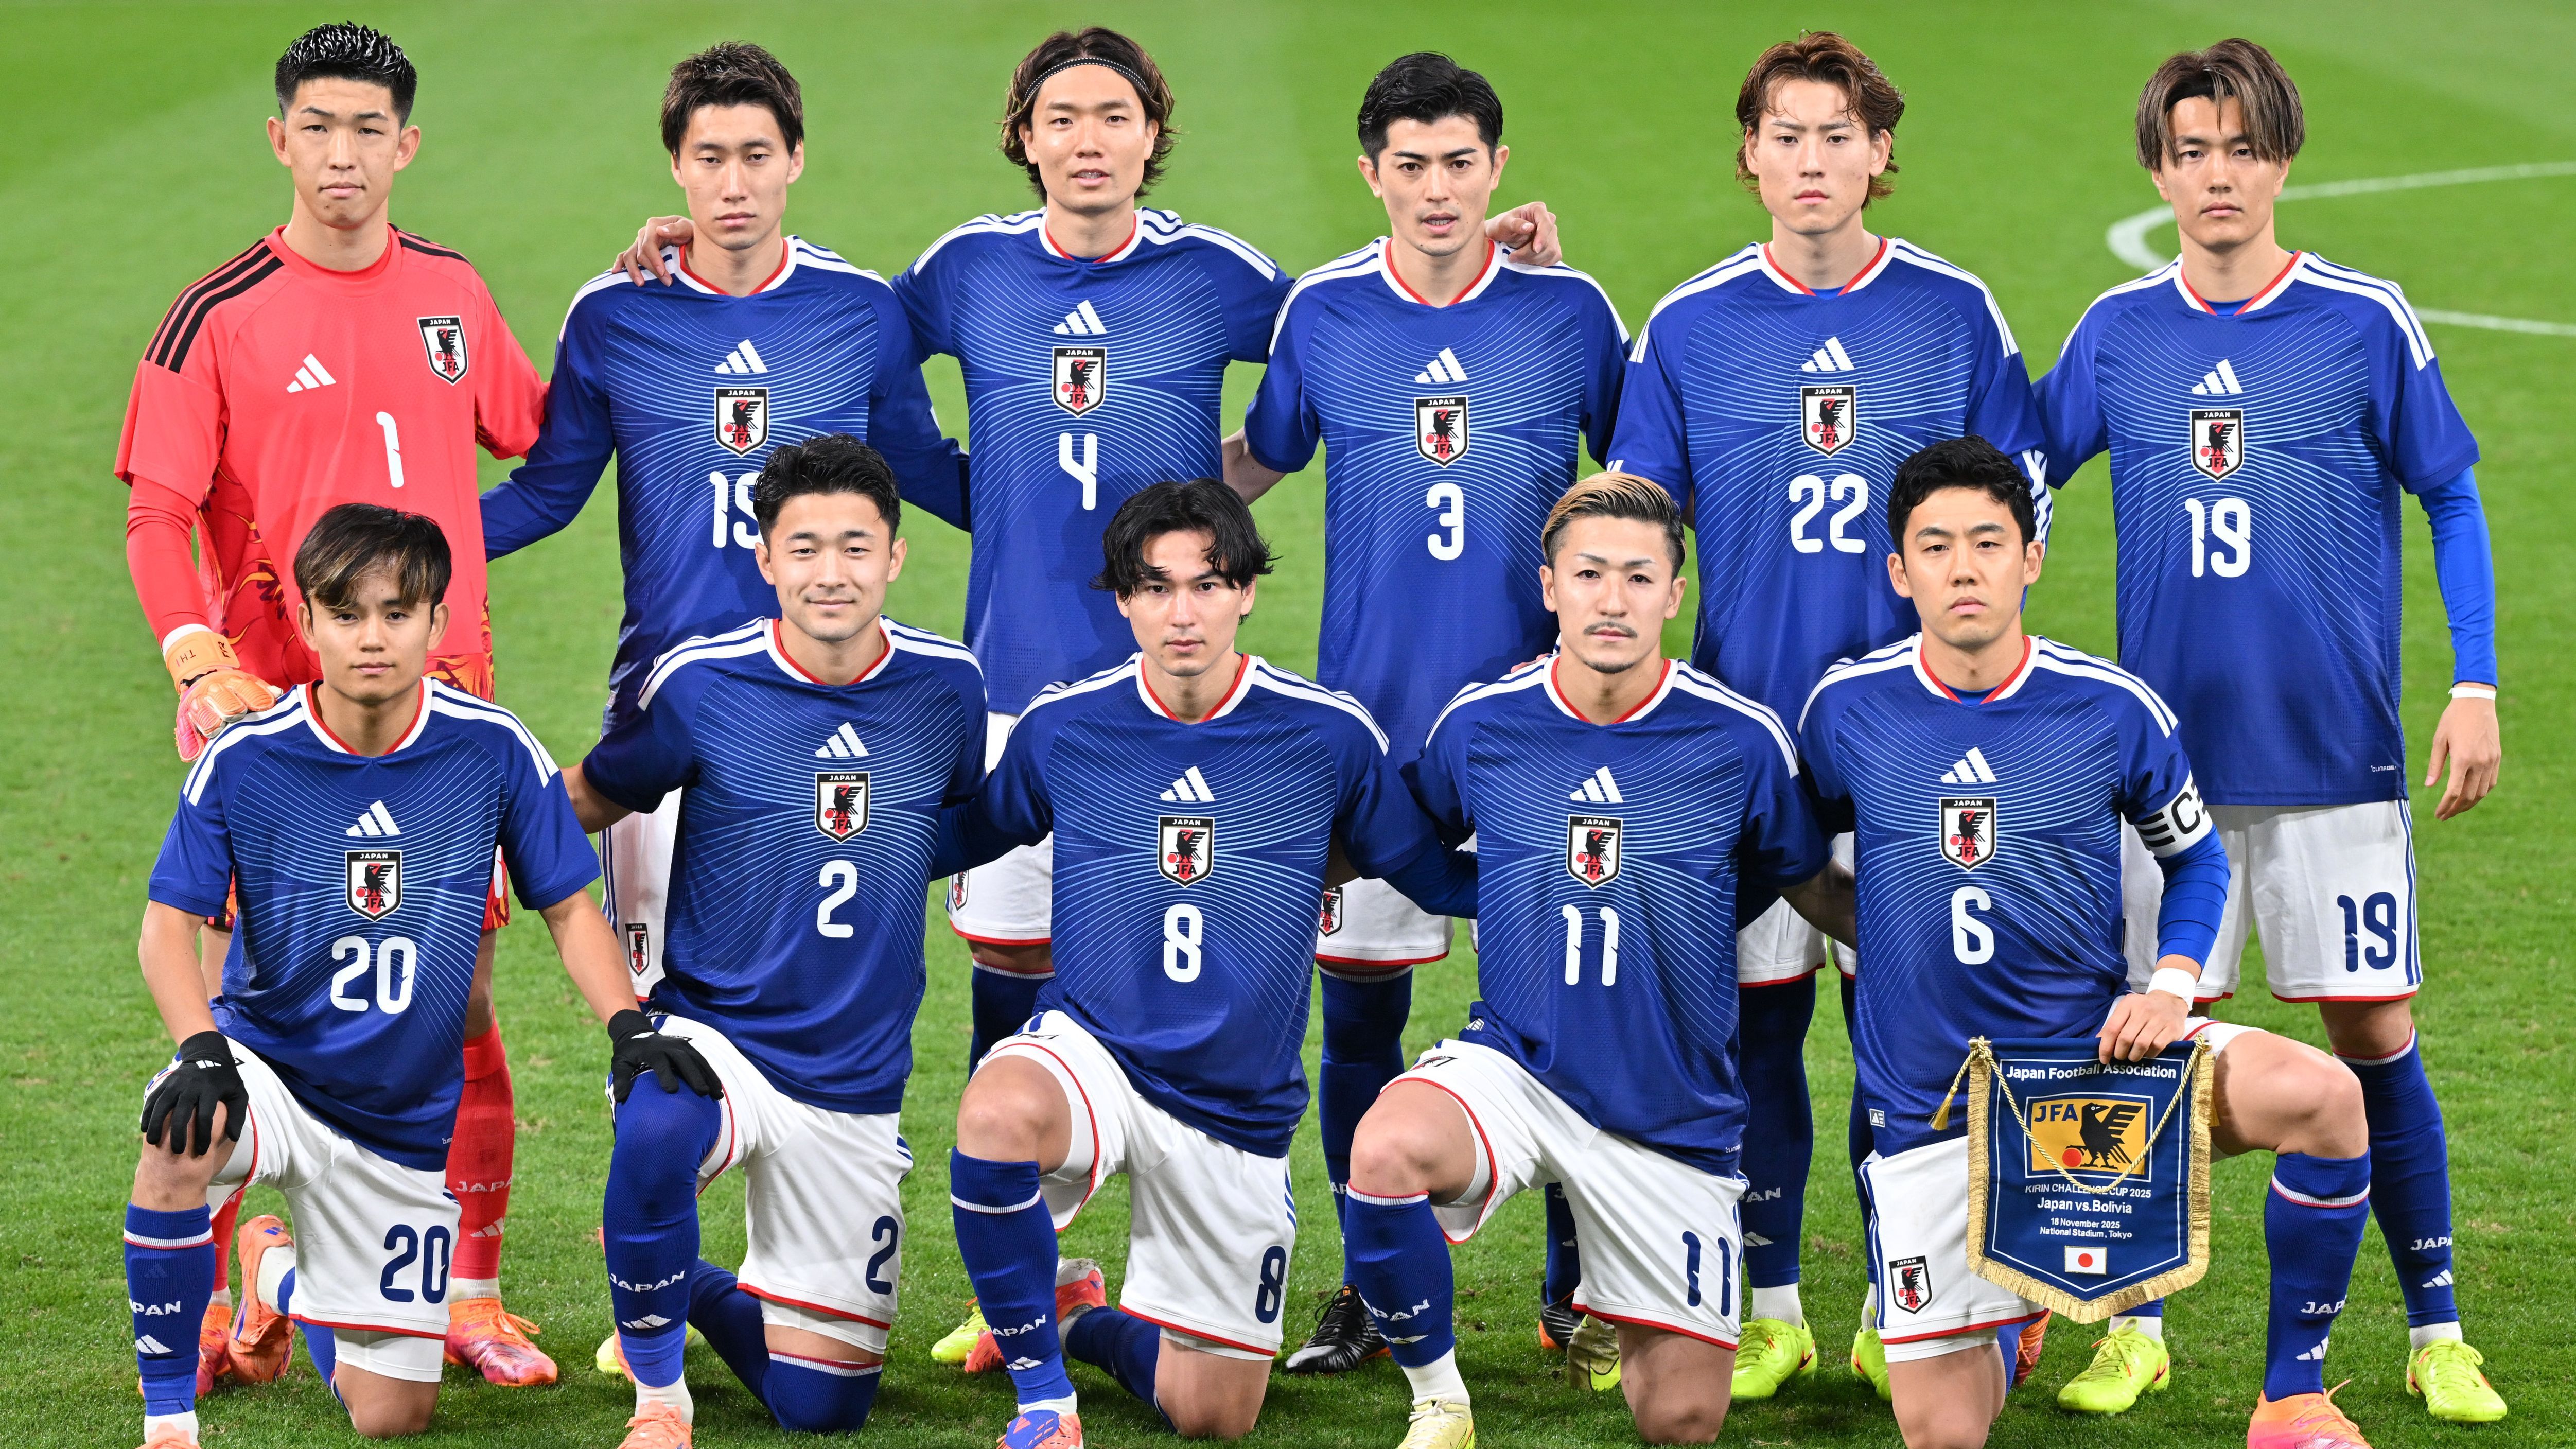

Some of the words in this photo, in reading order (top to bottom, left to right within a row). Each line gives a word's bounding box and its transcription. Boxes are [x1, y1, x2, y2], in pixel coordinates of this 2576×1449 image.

[442, 361, 460, 372] JFA
[1066, 394, 1090, 404] JFA
[729, 433, 753, 443] JFA
[1817, 433, 1841, 444] JFA
[376, 411, 404, 488] 1
[1432, 443, 1455, 453] JFA
[1059, 432, 1098, 510] 4
[2206, 457, 2229, 468] JFA
[1426, 482, 1464, 561] 3
[1789, 473, 1869, 553] 22
[2185, 498, 2251, 578] 19
[830, 819, 853, 830] JFA
[1955, 846, 1981, 858] JFA
[1172, 864, 1197, 875] JFA
[1581, 863, 1606, 876] JFA
[361, 897, 387, 909] JFA
[817, 860, 858, 938] 2
[1951, 886, 1994, 965] 6
[2336, 891, 2397, 972] 19
[1163, 903, 1203, 983] 8
[1562, 904, 1619, 986] 11
[330, 936, 419, 1014] 20
[2006, 1066, 2046, 1081] Japan
[2048, 1063, 2100, 1080] Football
[2103, 1063, 2177, 1079] Association
[2034, 1103, 2079, 1123] JFA
[455, 1176, 511, 1192] JAP
[2025, 1184, 2049, 1193] KIRIN
[2109, 1186, 2128, 1197] CUP
[2129, 1188, 2151, 1198] 2025
[2037, 1197, 2073, 1212] Japan
[2050, 1217, 2059, 1226] 18
[2060, 1218, 2099, 1228] November
[2101, 1220, 2121, 1229] 2025
[2039, 1226, 2071, 1236] National
[2108, 1230, 2132, 1239] Tokyo
[380, 1224, 451, 1304] 20
[865, 1215, 899, 1296] 2
[1897, 1258, 1917, 1266] JAPAN
[609, 1270, 685, 1293] JAPAN
[1681, 1231, 1731, 1317] 11
[1254, 1245, 1287, 1324] 8
[129, 1297, 181, 1316] PAN
[1904, 1294, 1922, 1305] JFA
[2300, 1294, 2347, 1314] JAP
